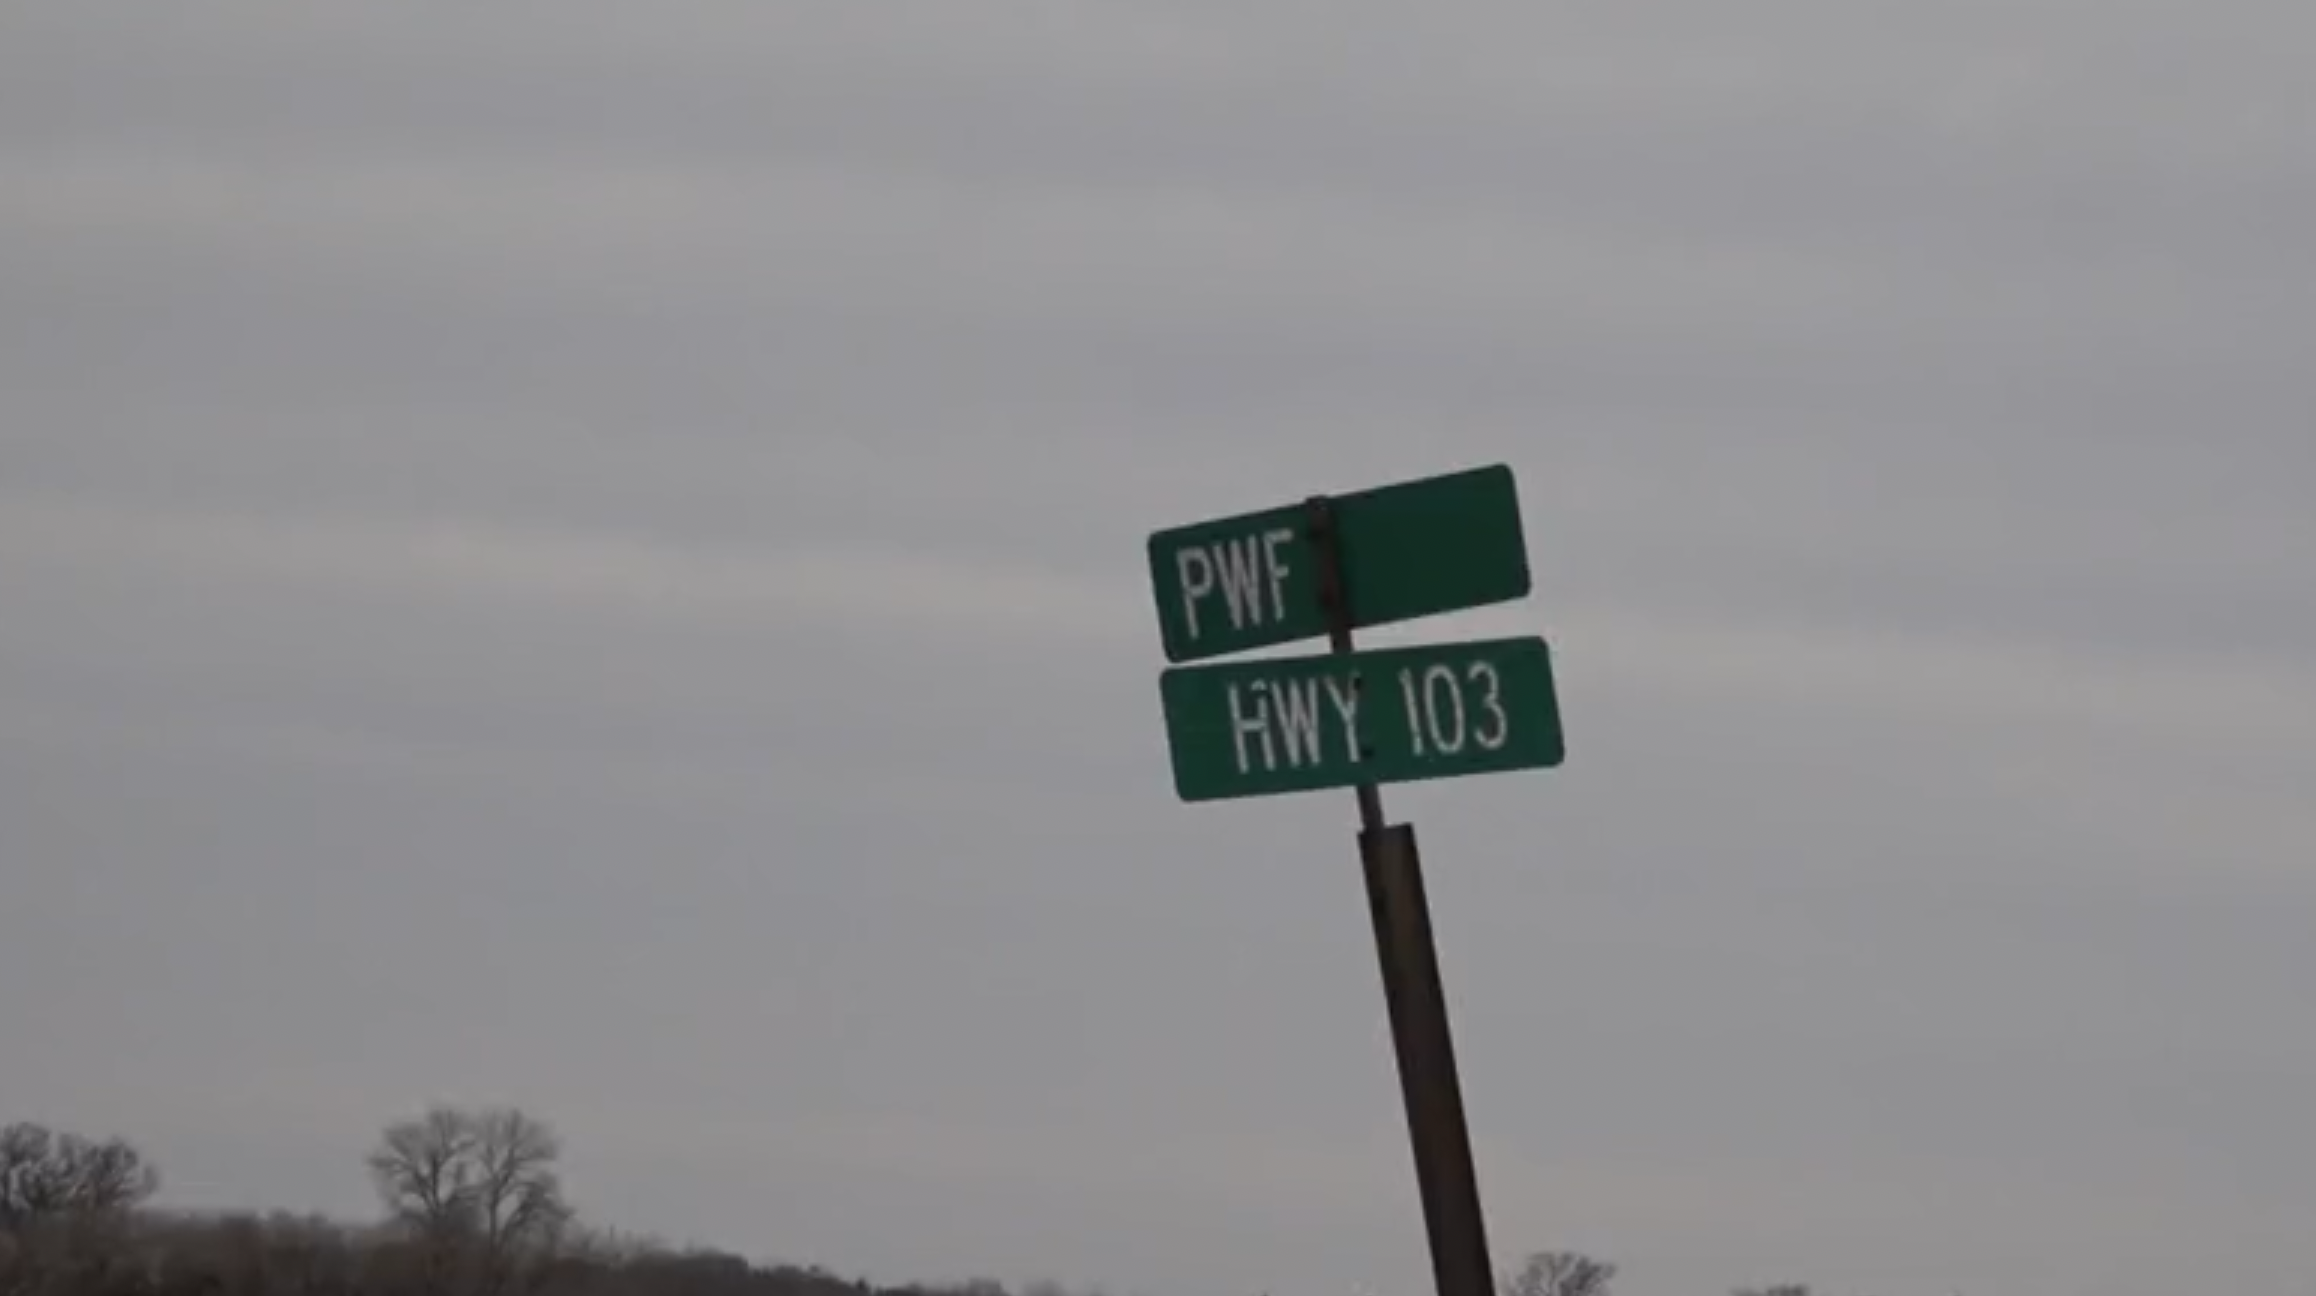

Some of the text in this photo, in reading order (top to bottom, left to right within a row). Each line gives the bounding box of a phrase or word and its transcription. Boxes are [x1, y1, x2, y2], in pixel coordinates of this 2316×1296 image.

[1176, 528, 1294, 640] PWF
[1227, 661, 1508, 774] HWY 103
